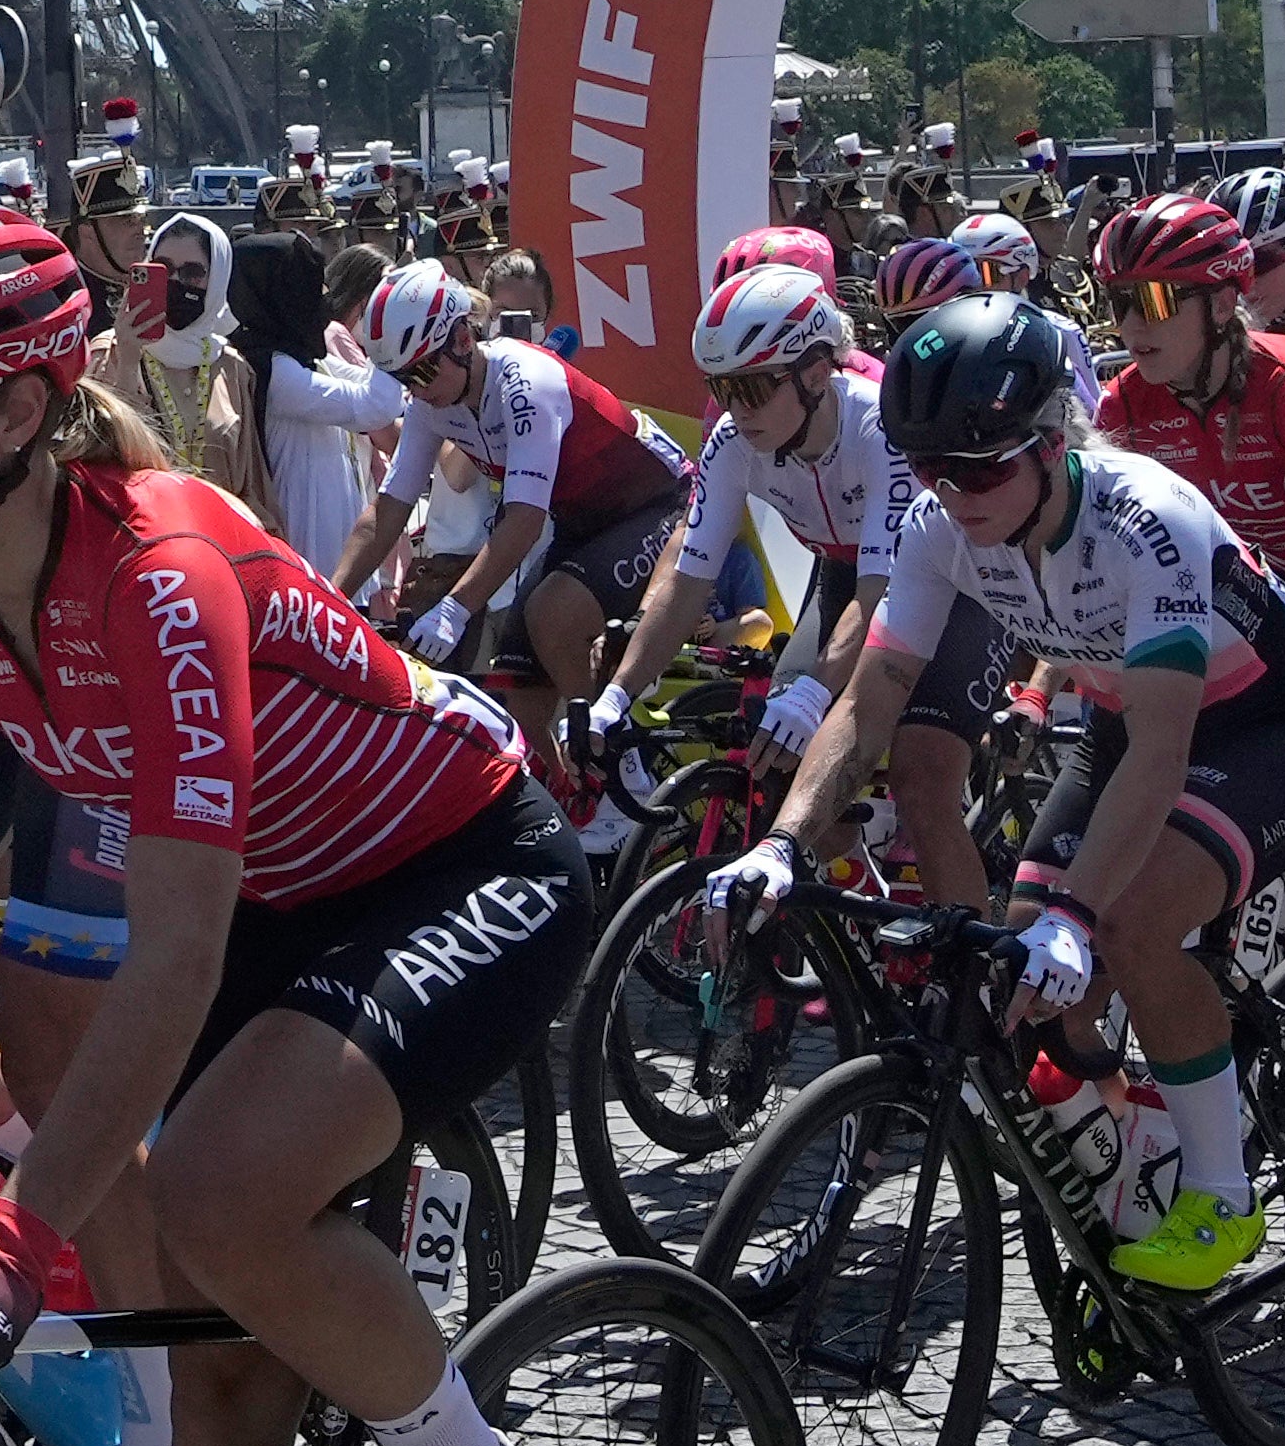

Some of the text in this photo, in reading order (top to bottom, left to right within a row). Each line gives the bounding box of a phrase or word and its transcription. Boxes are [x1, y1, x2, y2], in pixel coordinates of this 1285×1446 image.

[0, 271, 41, 297] ARKEA
[136, 568, 227, 763] ARKEA
[250, 586, 370, 682] ARKEA
[0, 719, 134, 780] RKE
[383, 874, 570, 1007] ARKEA
[1242, 892, 1277, 958] 165
[411, 1195, 463, 1295] 182
